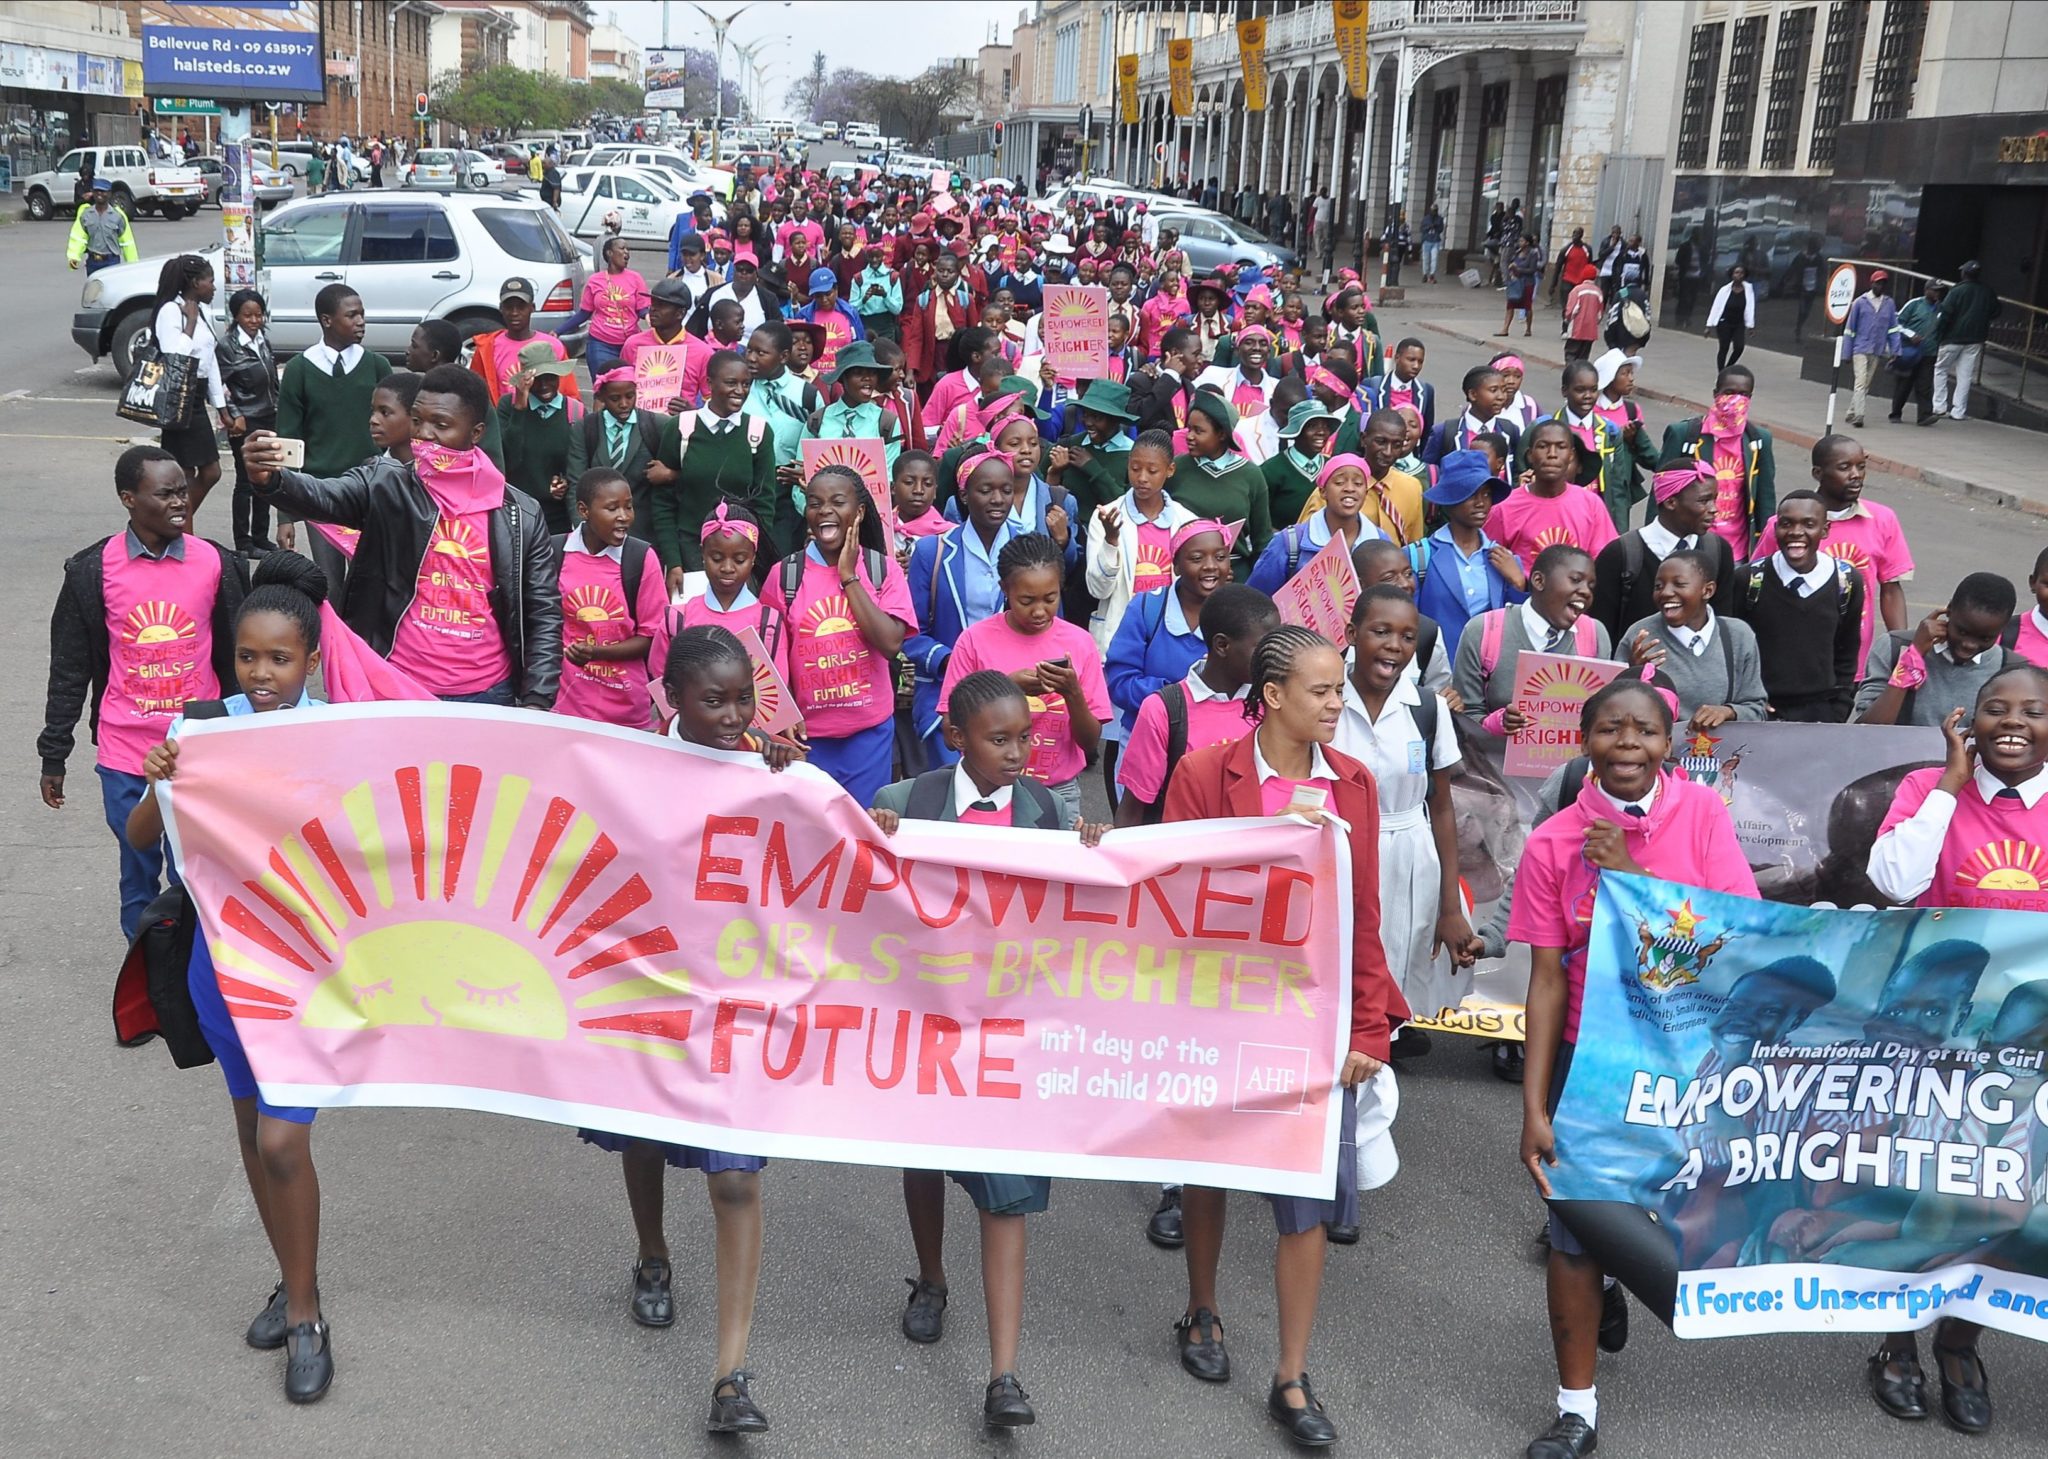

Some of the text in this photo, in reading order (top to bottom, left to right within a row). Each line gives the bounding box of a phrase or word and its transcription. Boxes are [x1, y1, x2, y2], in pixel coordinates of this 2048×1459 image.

[149, 36, 314, 56] Bellevue Rd 09 63591-7
[174, 57, 291, 76] halsteds.co.zw
[1048, 318, 1105, 330] EMPOWERED
[1048, 340, 1106, 354] BRIGHTER
[431, 571, 472, 591] GIRLS
[421, 605, 470, 625] FUTURE
[817, 650, 857, 669] GIRLS
[139, 662, 181, 679] GIRLS
[801, 660, 879, 690] BRIGHTER
[814, 682, 860, 702] FUTURE
[1518, 700, 1583, 713] EMPOWE
[1513, 729, 1583, 745] BRIGHT
[1735, 820, 1773, 832] Affairs
[715, 918, 909, 985] GIRLS
[986, 937, 1316, 1019] BRIGHTER
[1697, 1004, 1721, 1015] and
[710, 996, 1024, 1100] FUTURE
[1040, 1024, 1220, 1065] int'l day of the
[1751, 1040, 1878, 1061] International
[1883, 1041, 1921, 1064] Day
[1955, 1048, 1991, 1065] the
[1998, 1047, 2045, 1069] Girl
[1035, 1066, 1218, 1108] girl child 2019
[1246, 1065, 1295, 1094] AHF
[1624, 1063, 2015, 1128] EMPOWERING
[1658, 1130, 2027, 1202] A BRIGHTER
[1697, 1281, 1783, 1316] Force:
